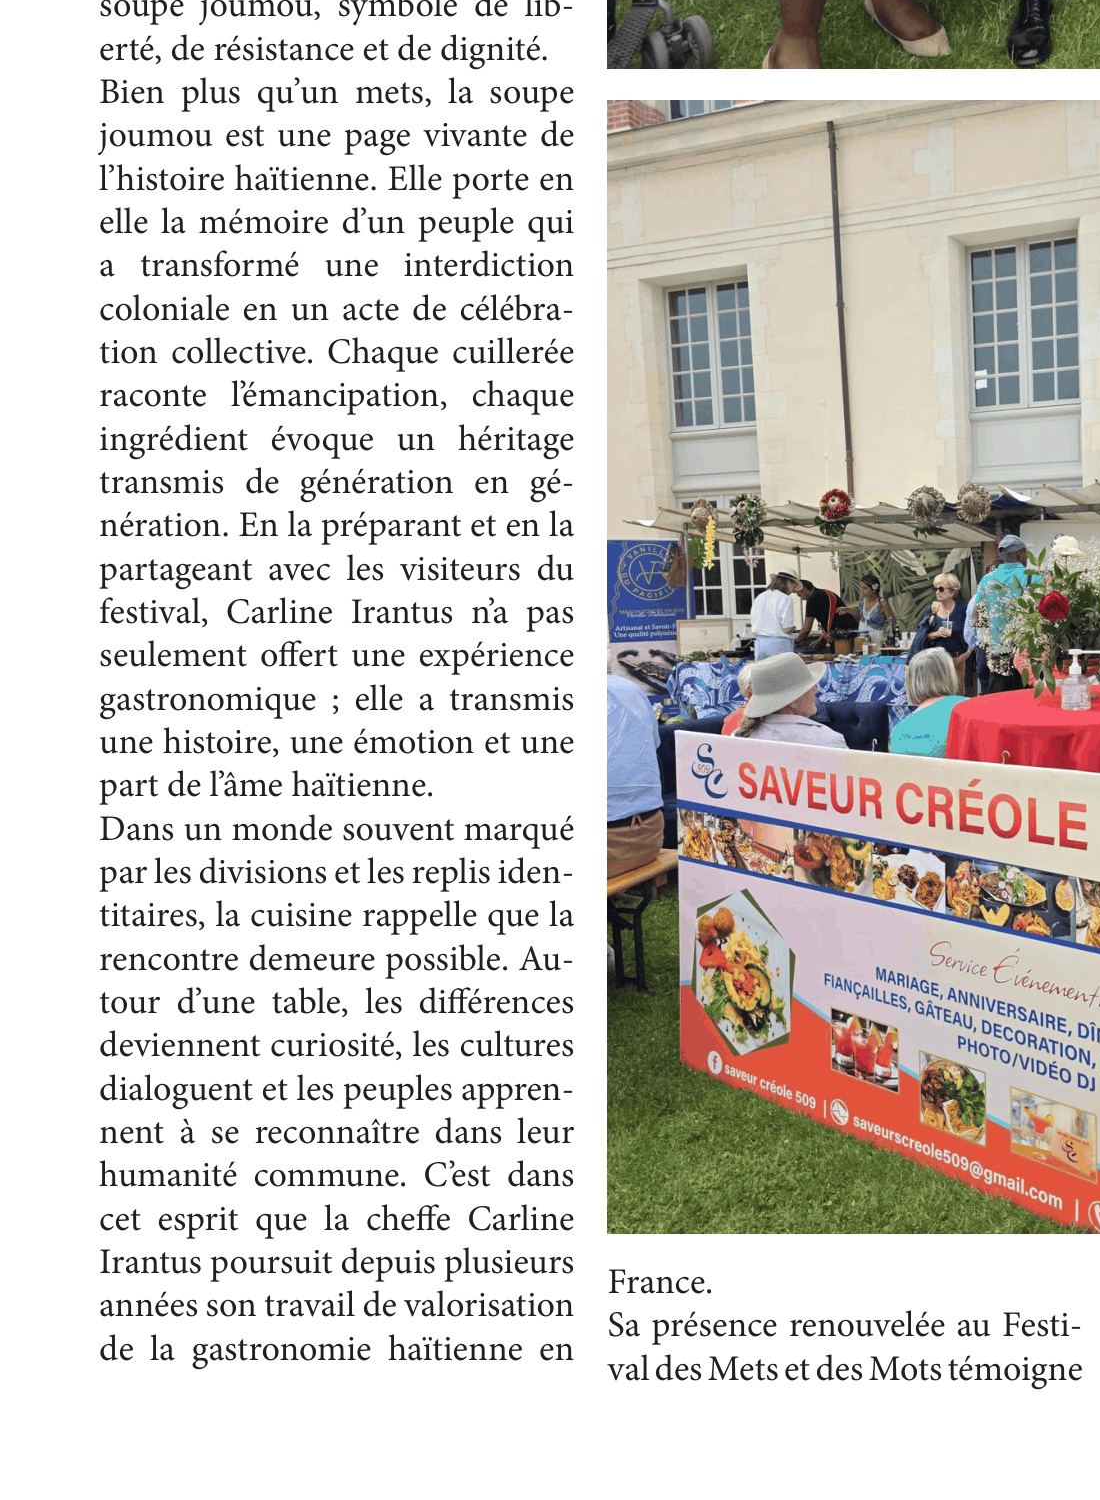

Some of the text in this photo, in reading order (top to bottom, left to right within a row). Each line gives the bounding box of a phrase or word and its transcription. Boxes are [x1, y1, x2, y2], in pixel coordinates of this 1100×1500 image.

[100, 424, 573, 459] ingrédient évoque un héritage
[650, 629, 677, 638] polynési
[100, 640, 573, 675] seulement offert une expérience
[738, 761, 883, 820] SAVEUR
[895, 778, 1088, 851] CRÉOLE
[929, 940, 988, 978] Service
[875, 966, 944, 1001] MARIAGE,
[947, 986, 1073, 1037] ANNIVERSAIRE,
[823, 972, 911, 1013] FIANÇAILLES,
[915, 1000, 977, 1033] GÂTEAU,
[981, 1019, 1097, 1070] DECORATION,
[100, 1030, 573, 1060] deviennent curiosité, les cultures
[957, 1035, 1097, 1092] PHOTO/VIDÉO DJ
[723, 1062, 817, 1110] saveur créole 509
[852, 1114, 1064, 1211] saveurscreole509@gmail.com
[100, 1247, 573, 1282] Irantus poursuit depuis plusieurs
[609, 1269, 711, 1294] France.
